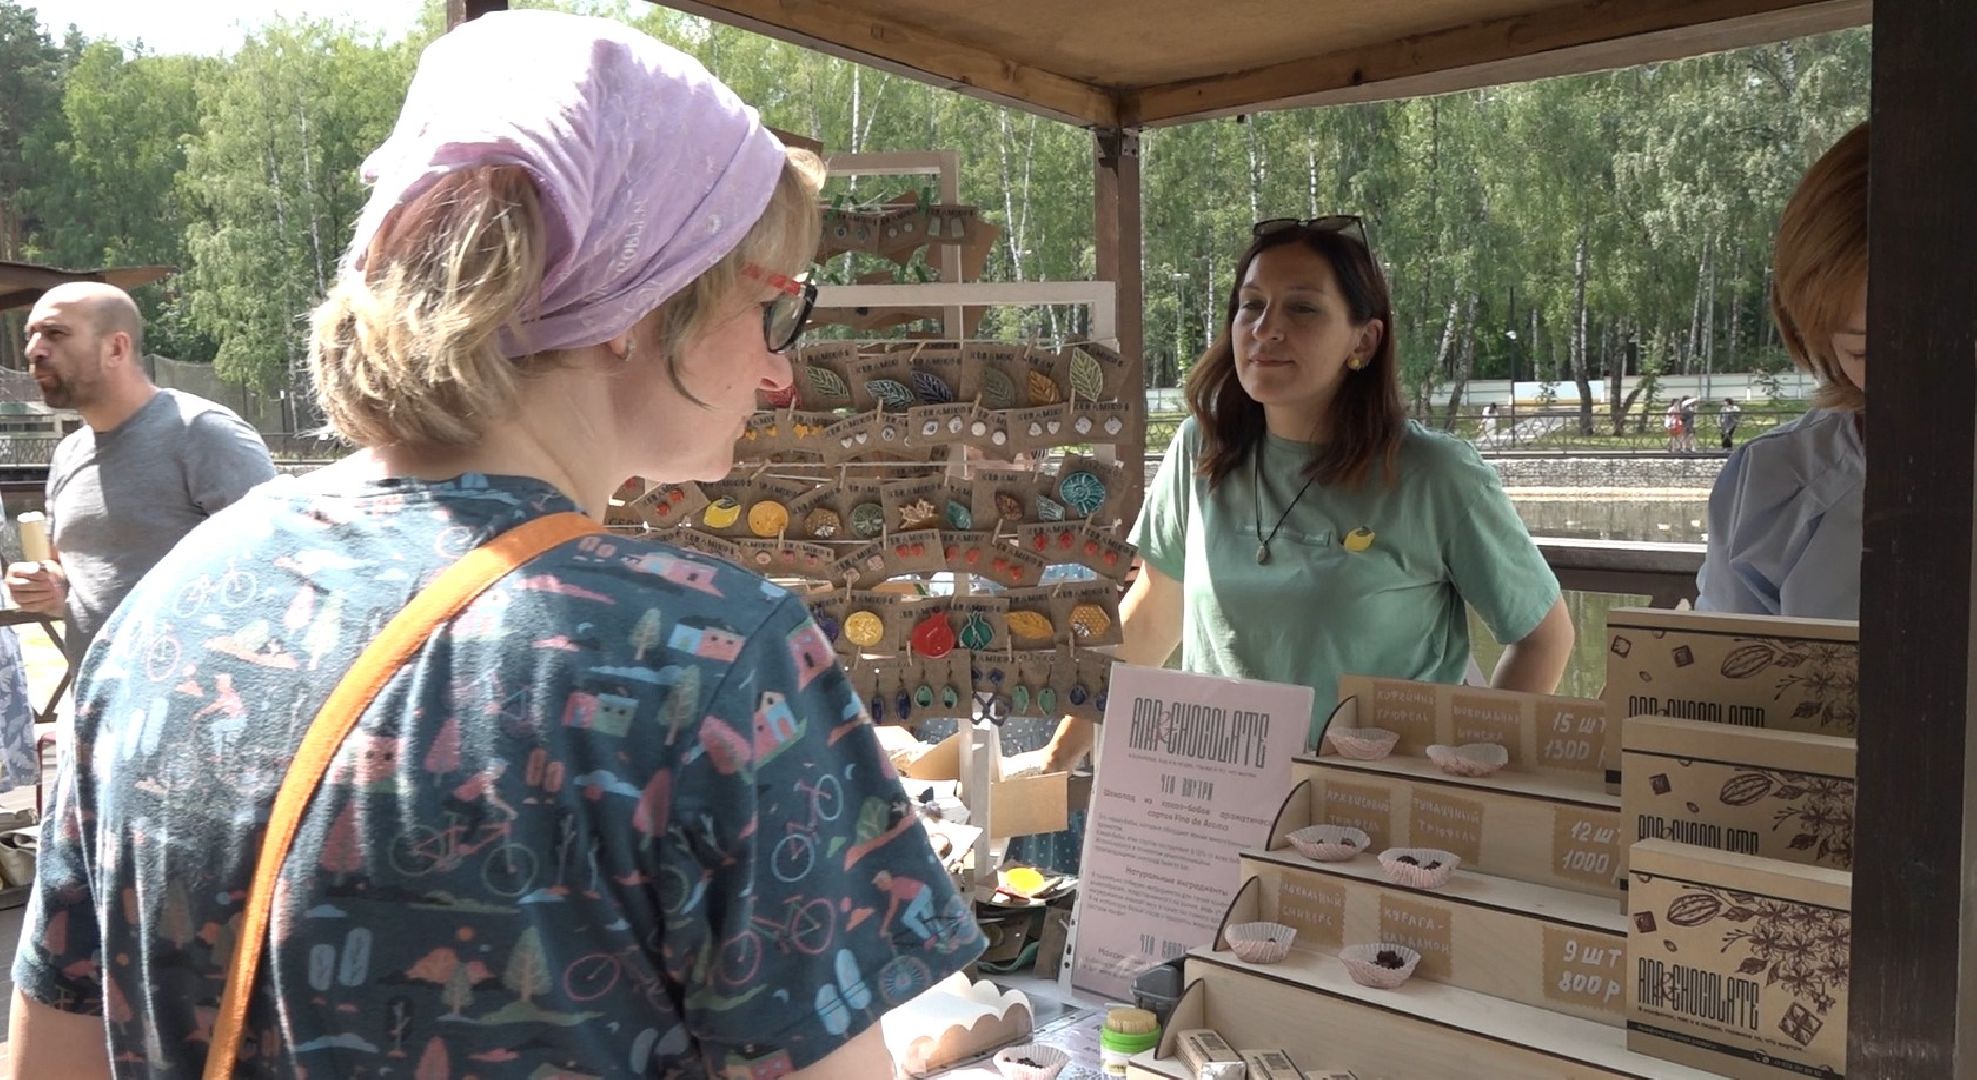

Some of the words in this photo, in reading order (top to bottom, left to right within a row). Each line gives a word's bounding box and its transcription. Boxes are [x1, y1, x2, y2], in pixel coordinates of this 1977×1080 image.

[1553, 711, 1574, 733] 15
[1174, 813, 1190, 825] Fino
[1571, 820, 1592, 843] 12
[1562, 849, 1610, 874] 1000
[1562, 939, 1578, 962] 9
[1558, 970, 1602, 995] 800
